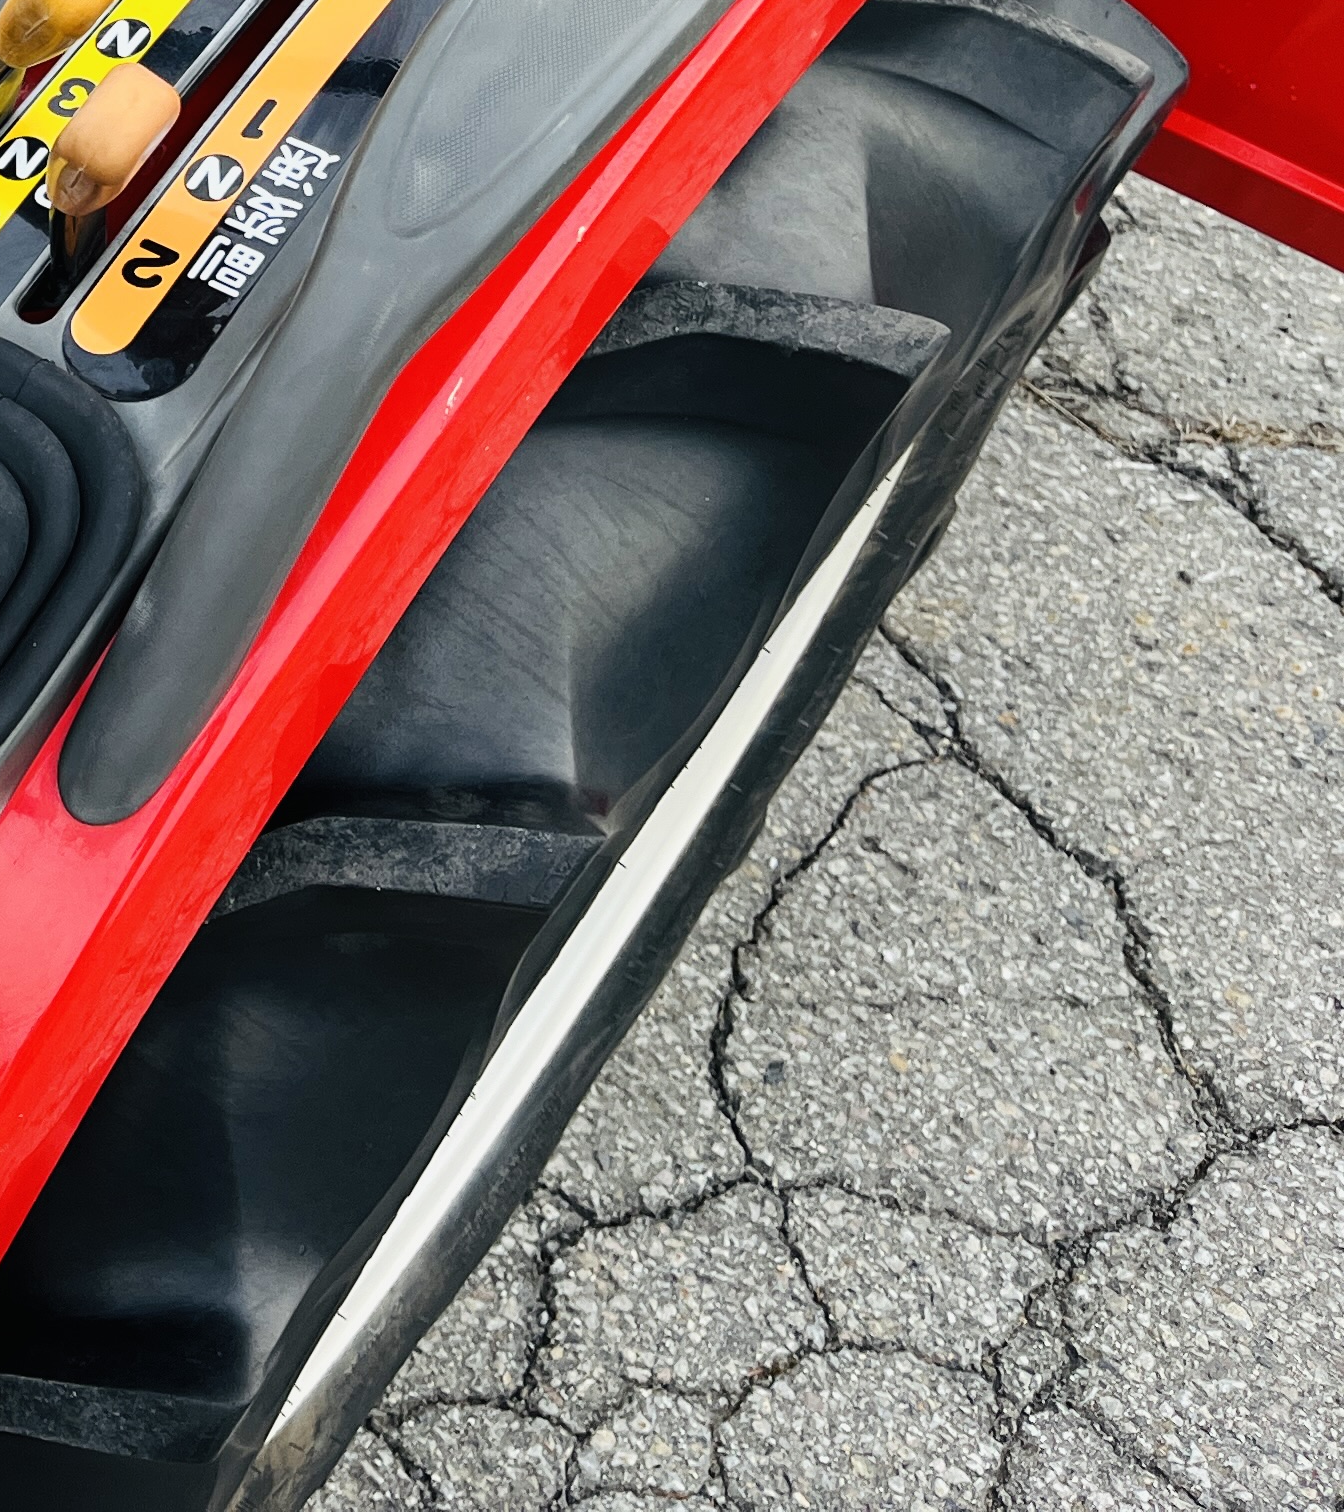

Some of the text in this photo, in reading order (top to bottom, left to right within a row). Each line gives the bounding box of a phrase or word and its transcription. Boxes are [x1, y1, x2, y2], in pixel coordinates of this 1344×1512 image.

[96, 20, 151, 58] N
[240, 99, 278, 140] 1
[187, 157, 243, 199] N
[187, 134, 342, 299] 副変速
[121, 238, 180, 289] 2
